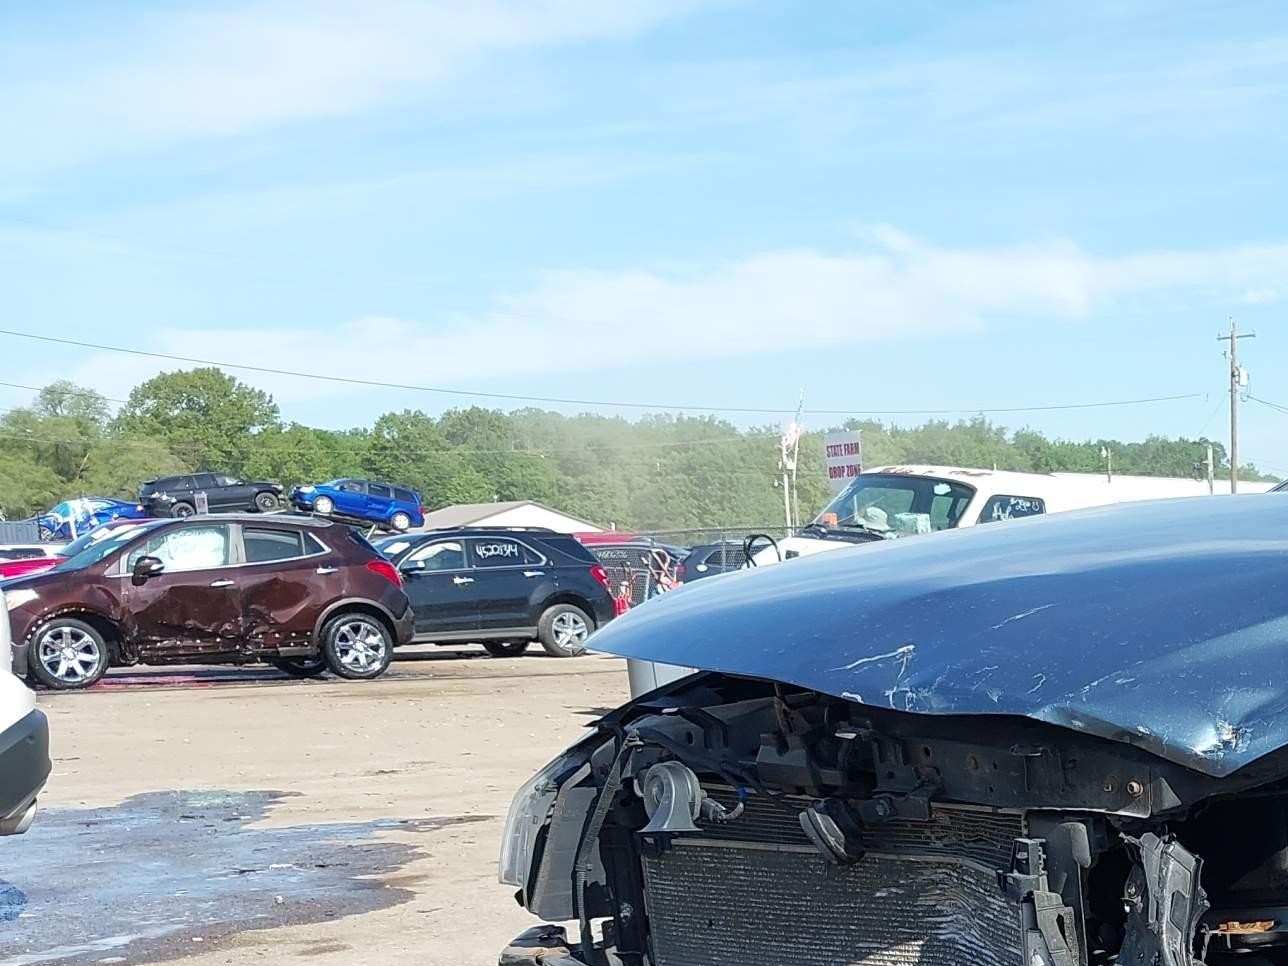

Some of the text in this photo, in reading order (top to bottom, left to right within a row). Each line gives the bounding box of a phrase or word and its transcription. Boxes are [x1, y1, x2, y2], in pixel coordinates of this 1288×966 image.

[826, 442, 860, 458] STATE FARM
[829, 465, 845, 479] DROP
